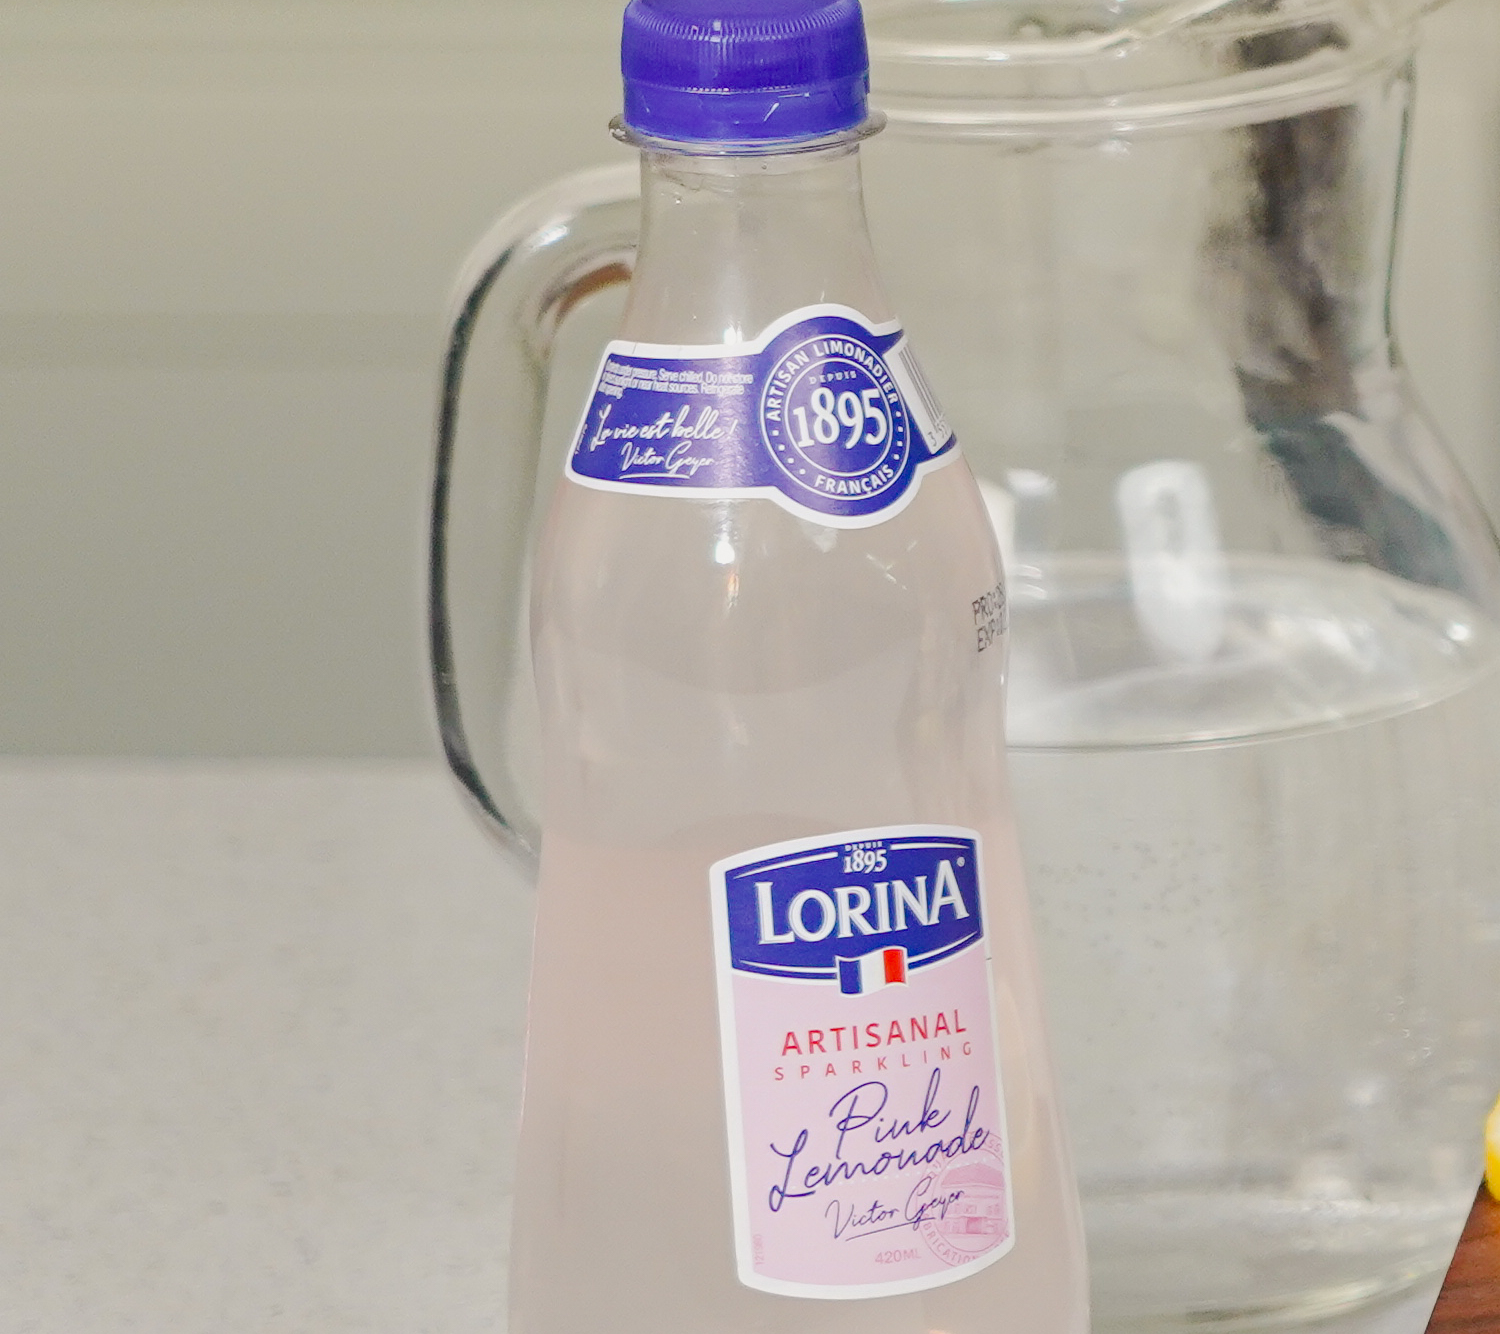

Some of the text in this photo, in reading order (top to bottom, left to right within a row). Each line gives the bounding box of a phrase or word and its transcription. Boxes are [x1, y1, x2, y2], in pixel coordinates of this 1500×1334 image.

[767, 340, 899, 422] ARTISAN LIMONADIER
[808, 370, 857, 385] DEPUIS
[793, 386, 888, 450] 1895
[813, 463, 894, 495] FRANÇAIS
[844, 848, 888, 874] 1895
[755, 859, 970, 945] LORINA
[781, 1009, 966, 1056] ARTISANAL
[774, 1041, 972, 1081] SPARKLING
[829, 1067, 951, 1159] Pink
[769, 1085, 990, 1212] Lemonade
[825, 1199, 899, 1240] Victor
